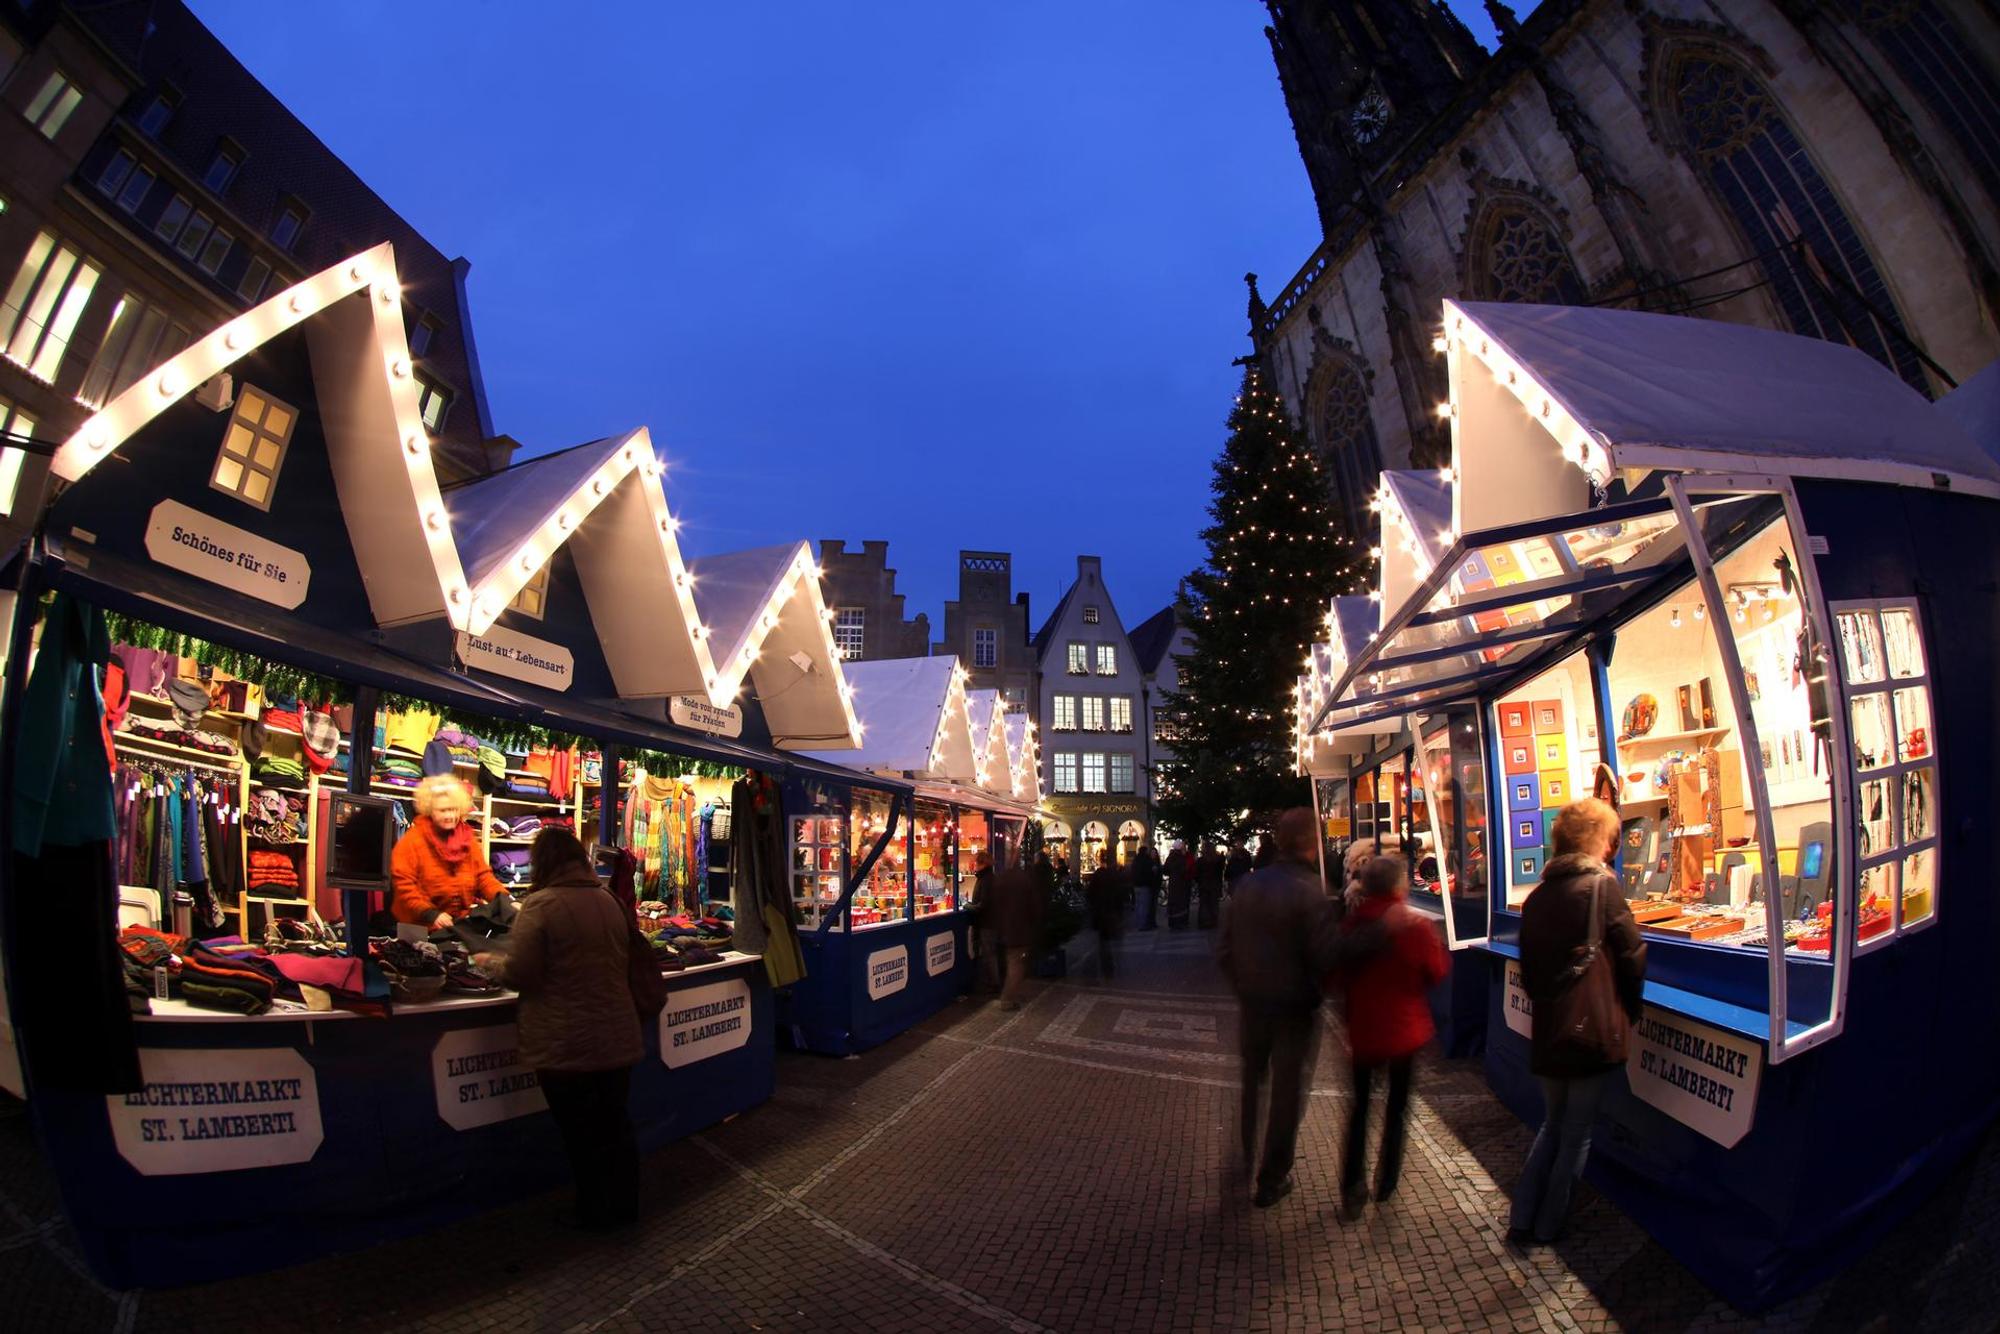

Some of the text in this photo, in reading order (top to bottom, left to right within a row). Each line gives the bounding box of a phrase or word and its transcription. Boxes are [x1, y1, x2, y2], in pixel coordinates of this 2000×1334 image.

[171, 526, 287, 583] Schönes für Sie
[467, 634, 494, 653] Lust
[515, 650, 566, 675] Lebensart
[680, 696, 699, 709] Mode
[690, 711, 702, 722] für
[1102, 804, 1138, 814] SIGNORA
[667, 996, 745, 1028] LICHTERMARKT
[673, 1016, 742, 1048] ST. LAMBERTI
[1638, 1015, 1749, 1078] LICHTERMARKT
[446, 1049, 519, 1078] LICHTER
[125, 1078, 302, 1107] LICHTERMARKT
[458, 1072, 540, 1104] ST. LAMB
[1640, 1049, 1735, 1112] ST. LAMBERTI
[140, 1111, 297, 1142] ST. LAMBERTI
